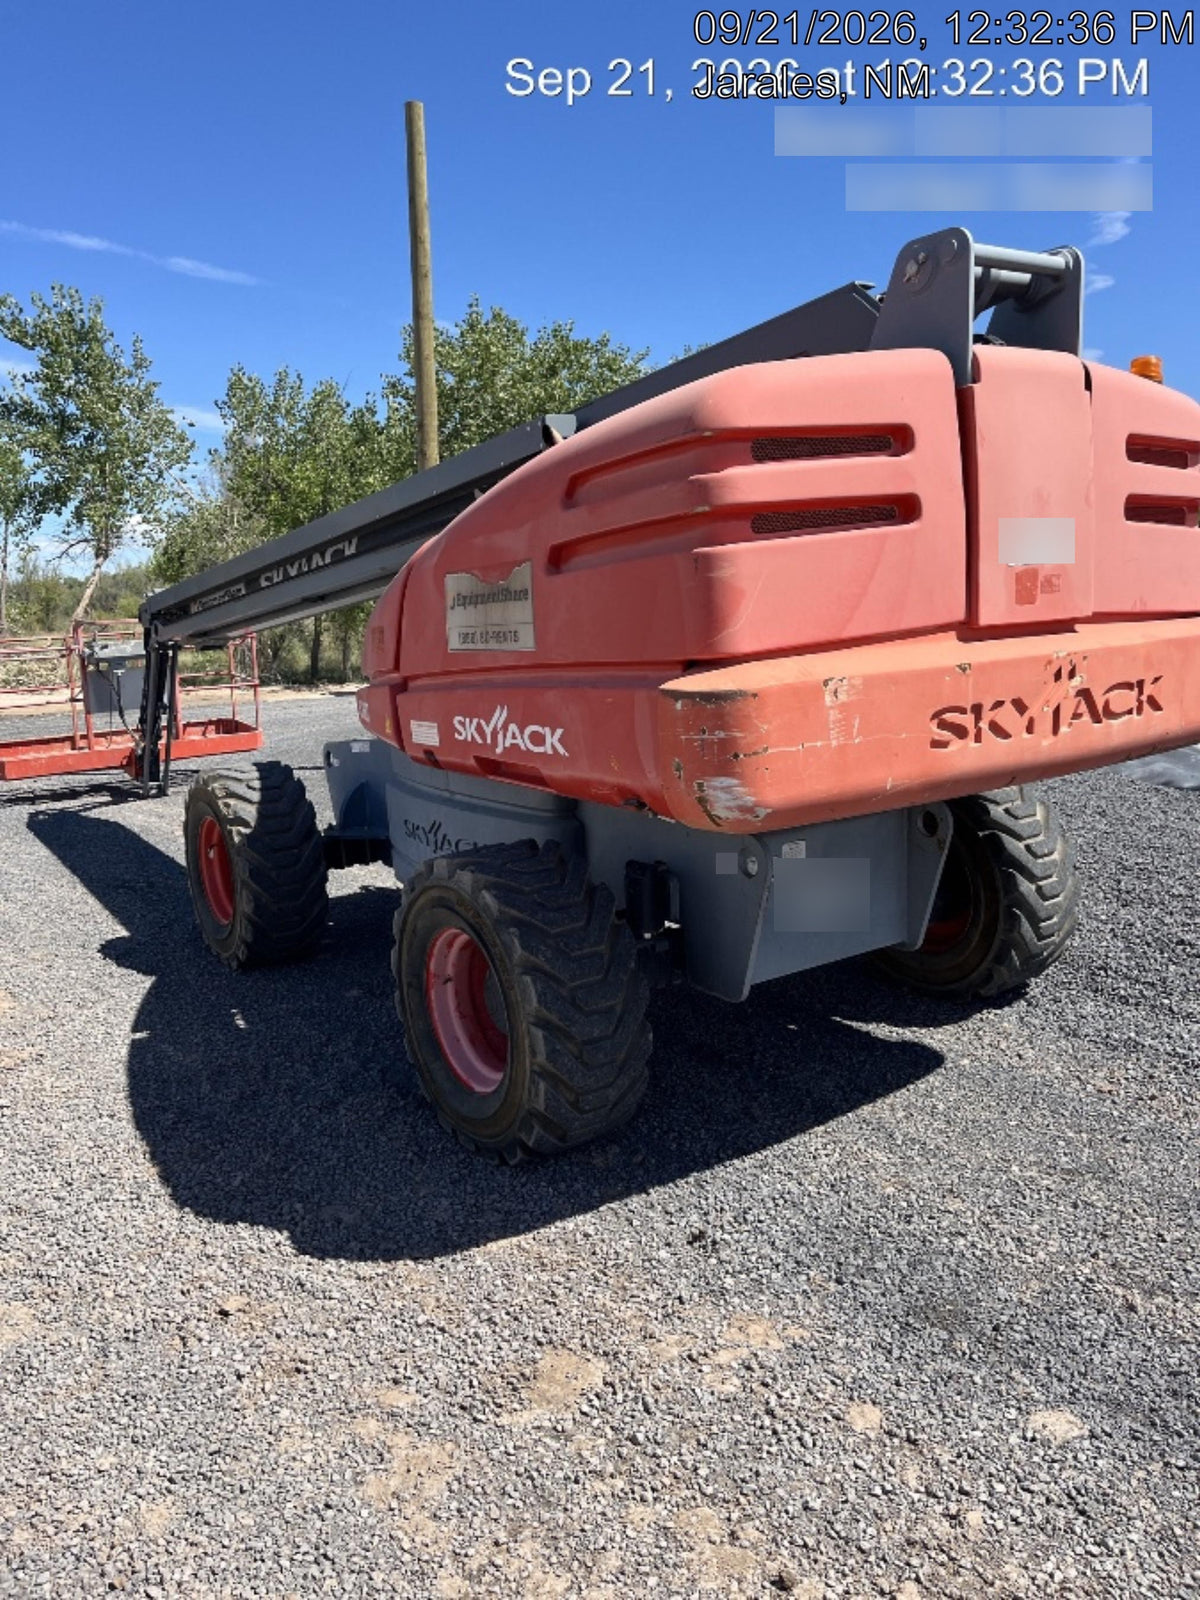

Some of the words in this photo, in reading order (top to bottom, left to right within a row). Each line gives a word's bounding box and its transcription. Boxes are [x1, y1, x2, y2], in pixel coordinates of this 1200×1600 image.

[453, 704, 569, 756] SKYJACK
[929, 660, 1164, 749] SKYJACK
[404, 819, 478, 854] SKYJAC
